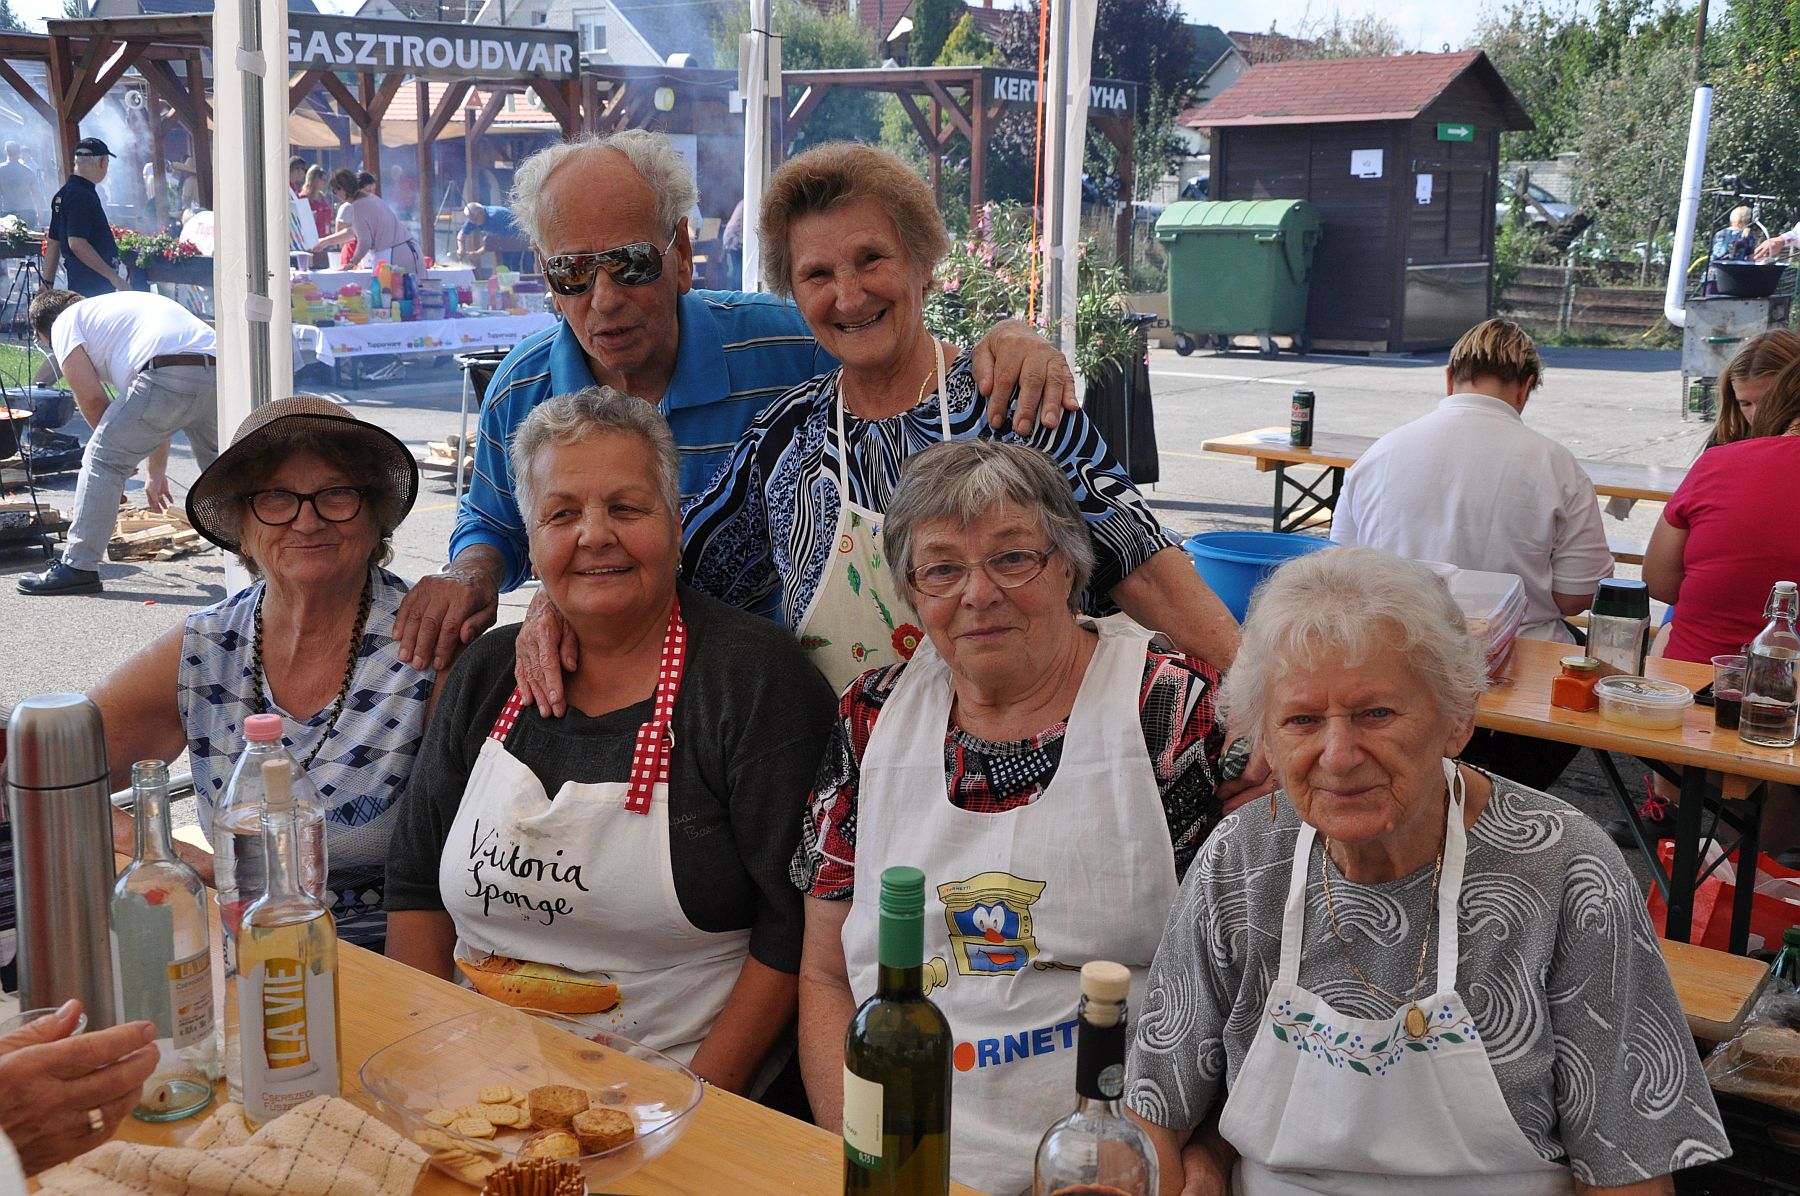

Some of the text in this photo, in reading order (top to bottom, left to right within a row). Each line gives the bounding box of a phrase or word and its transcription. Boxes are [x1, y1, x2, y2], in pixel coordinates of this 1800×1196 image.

[288, 29, 573, 73] GASZTROUDVAR
[470, 818, 589, 891] Victoria
[465, 860, 573, 925] Sponge
[264, 965, 306, 1060] LA VIE
